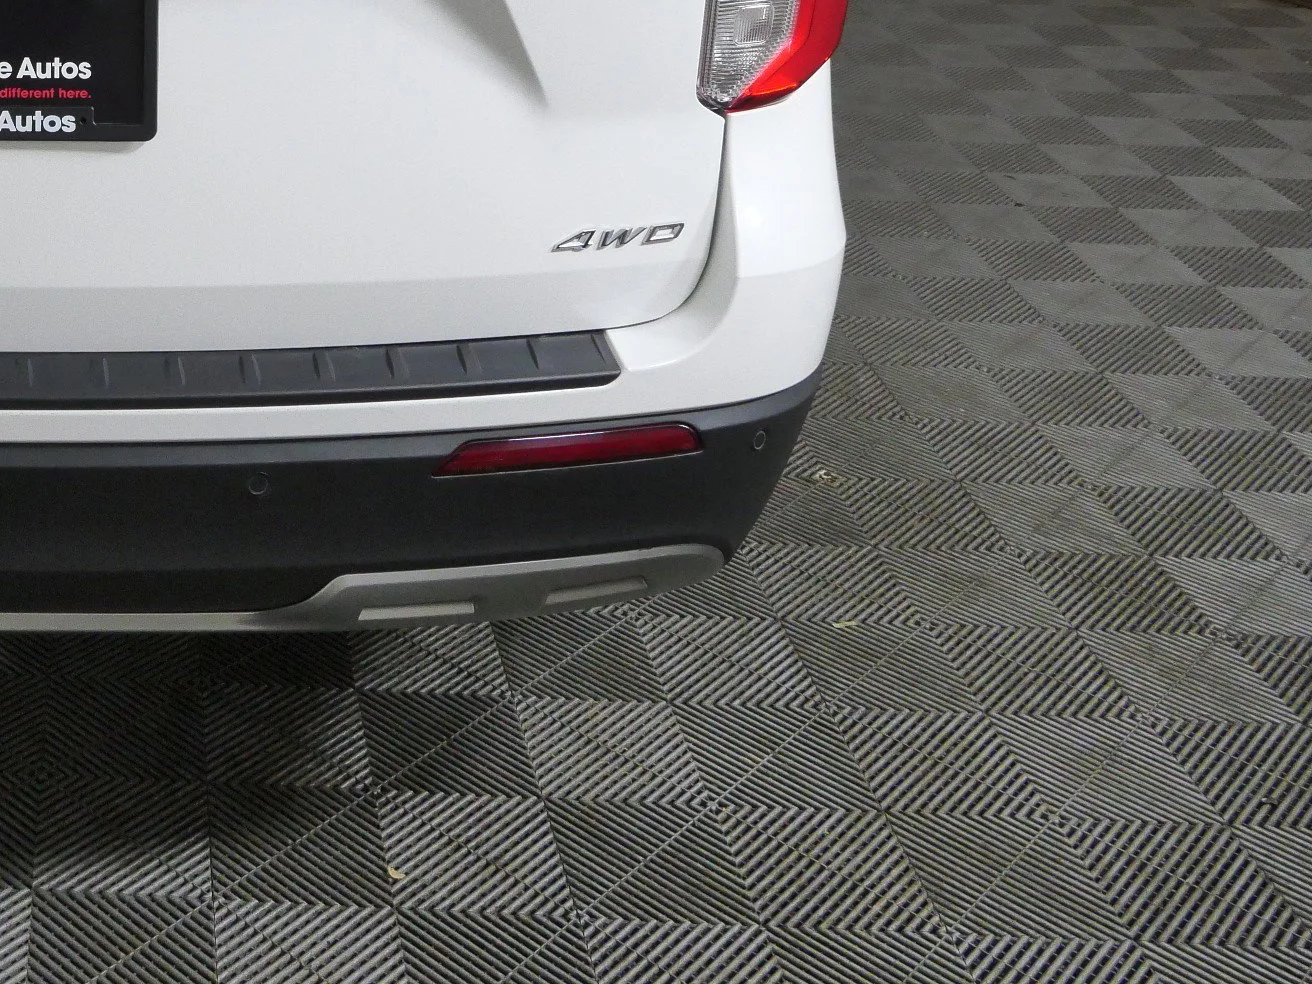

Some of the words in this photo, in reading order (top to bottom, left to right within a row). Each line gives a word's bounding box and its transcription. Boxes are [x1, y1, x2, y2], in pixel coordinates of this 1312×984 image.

[16, 56, 92, 80] Autos
[0, 87, 55, 99] different
[58, 87, 92, 99] here.
[550, 222, 685, 253] 4WD
